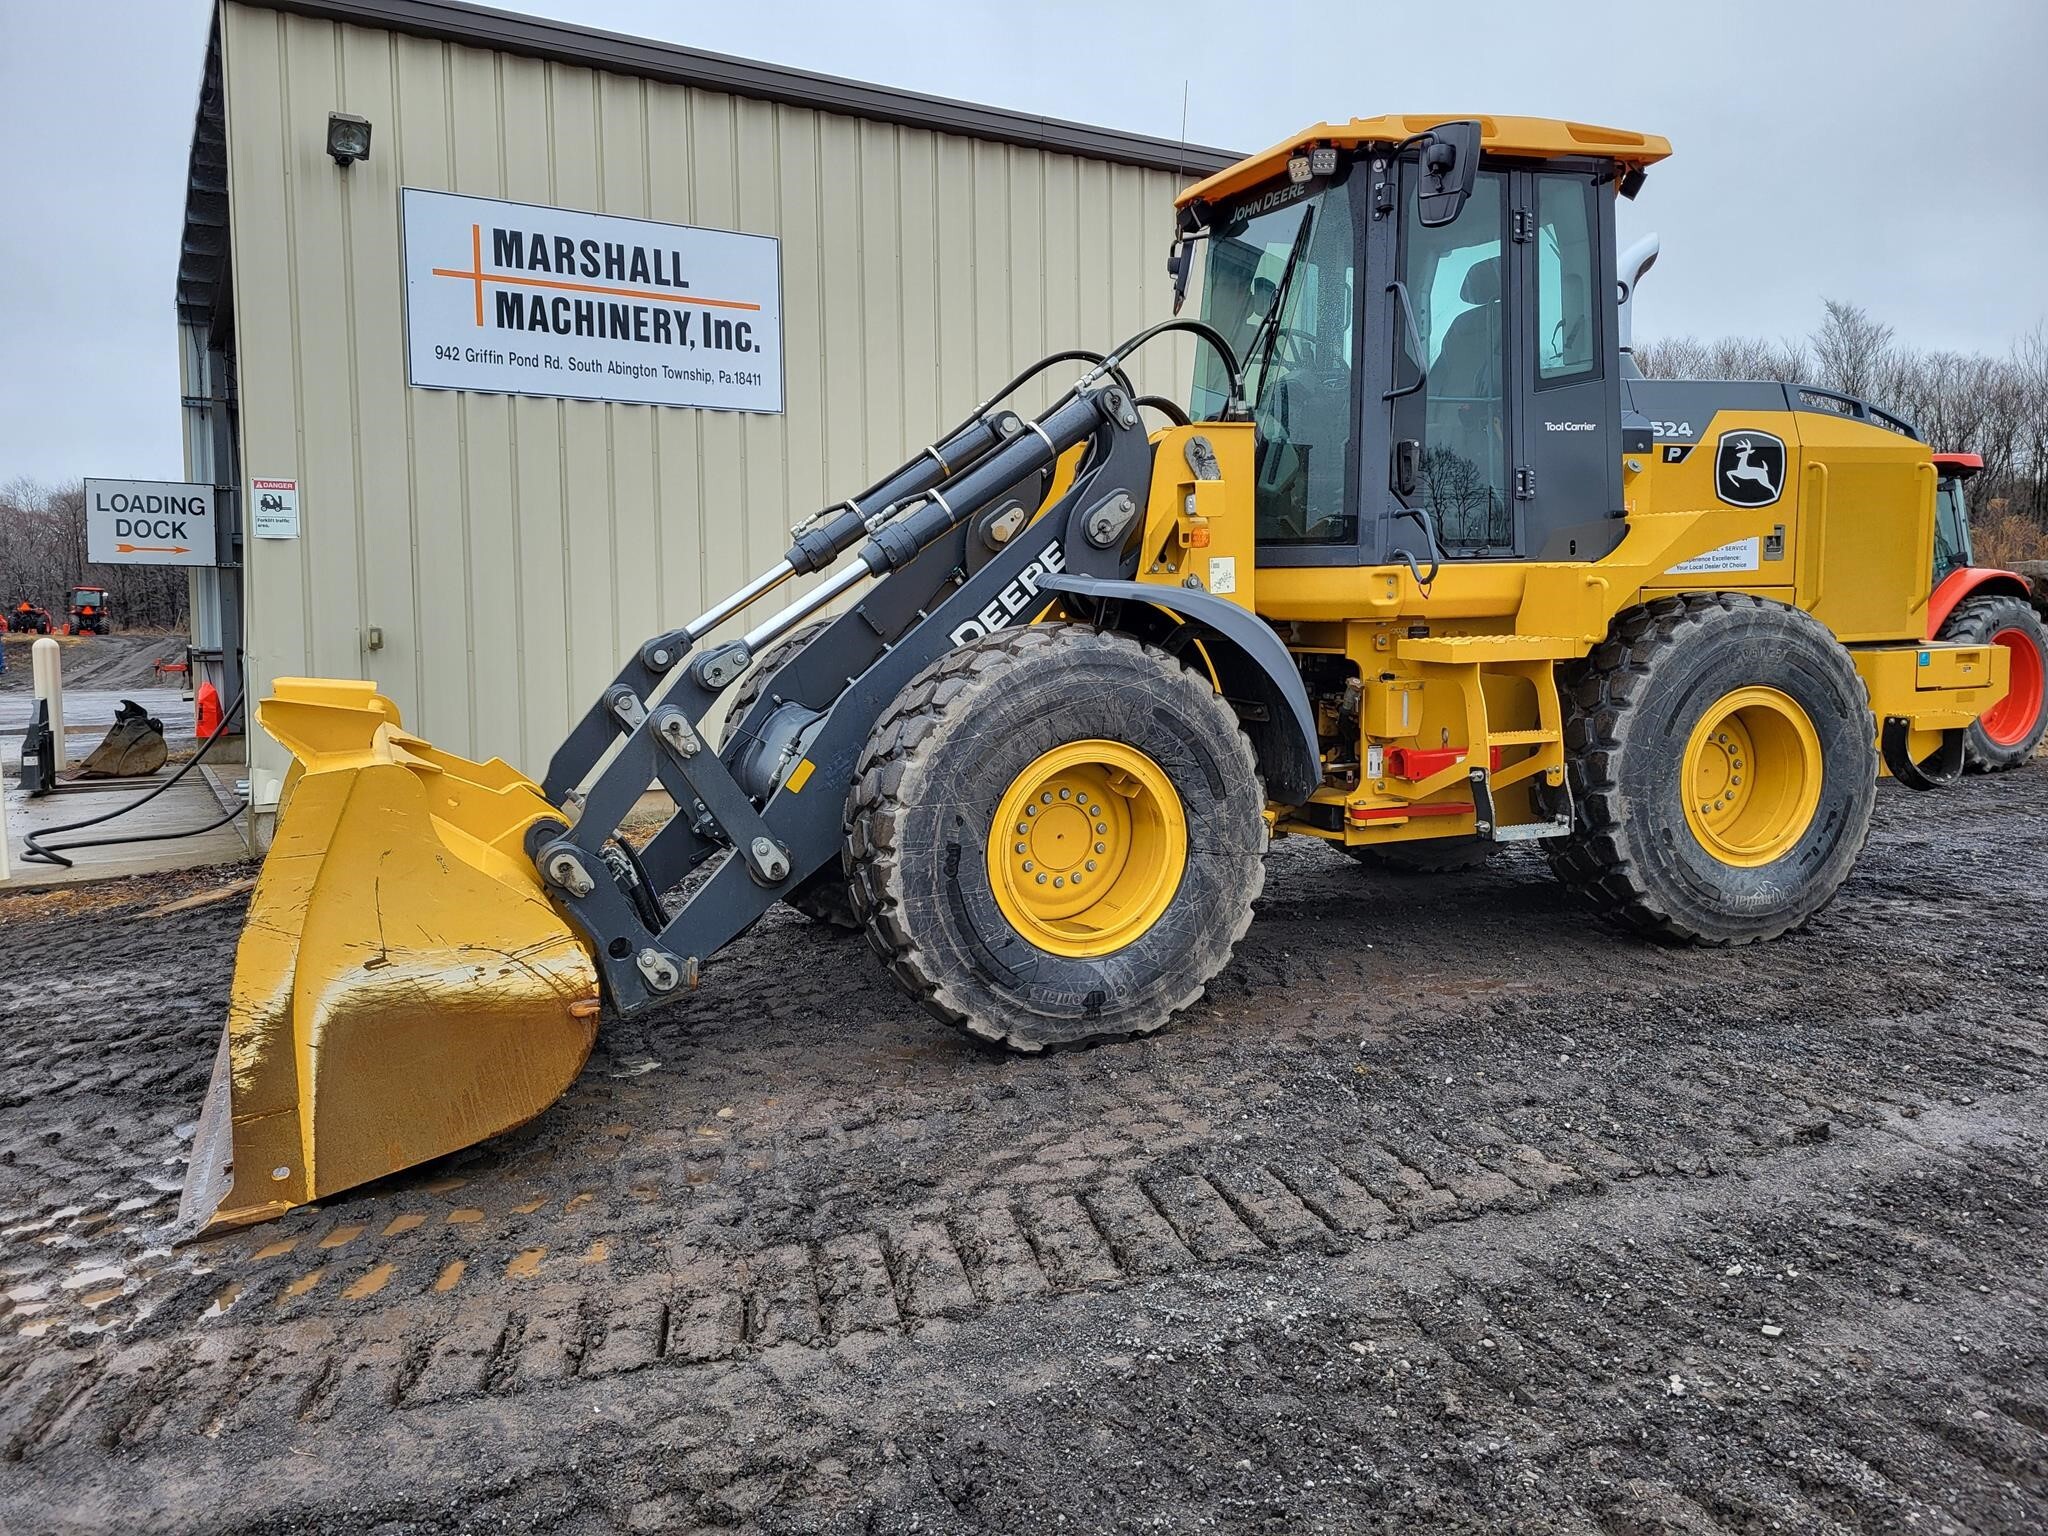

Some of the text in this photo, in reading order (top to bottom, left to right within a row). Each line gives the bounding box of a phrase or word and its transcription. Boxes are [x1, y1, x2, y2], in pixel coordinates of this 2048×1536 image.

[1230, 183, 1305, 224] JOHN DEERE
[493, 228, 690, 288] MARSHALL
[496, 291, 761, 353] MACHINERY, Inc.
[435, 345, 761, 386] 942 Griffin Pond Rd. South Abington Township, Pa.18411
[1545, 422, 1596, 431] Tool Carrier
[1650, 421, 1693, 437] 524
[1668, 447, 1682, 462] P
[96, 493, 206, 516] LOADING
[115, 519, 188, 540] DOCK
[949, 540, 1066, 648] DEERE
